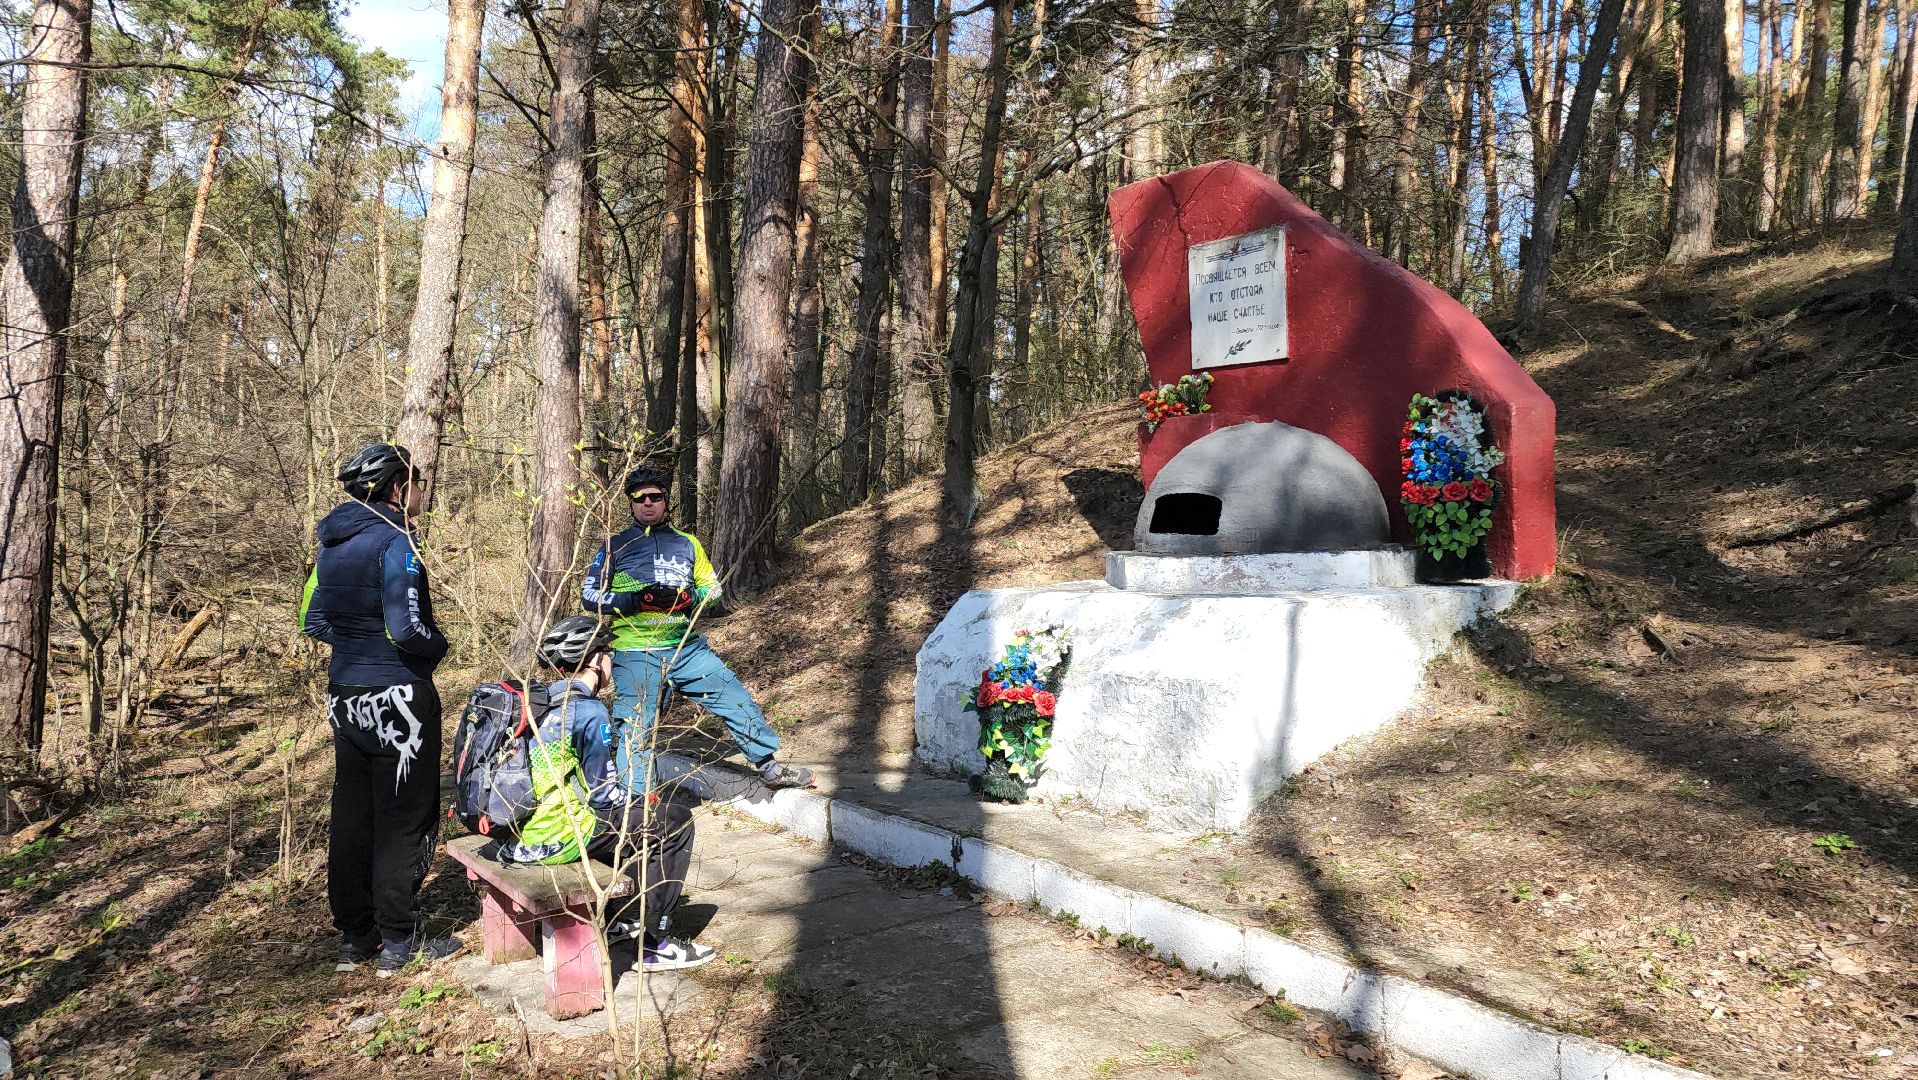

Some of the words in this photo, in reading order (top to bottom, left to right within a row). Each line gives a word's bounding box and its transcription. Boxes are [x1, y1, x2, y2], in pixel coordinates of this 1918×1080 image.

[1209, 291, 1223, 304] КТО
[1231, 284, 1264, 300] ОТСТОЯЛ
[1208, 310, 1228, 324] НАШЕ
[1233, 303, 1266, 319] СЧАСТЬЕ
